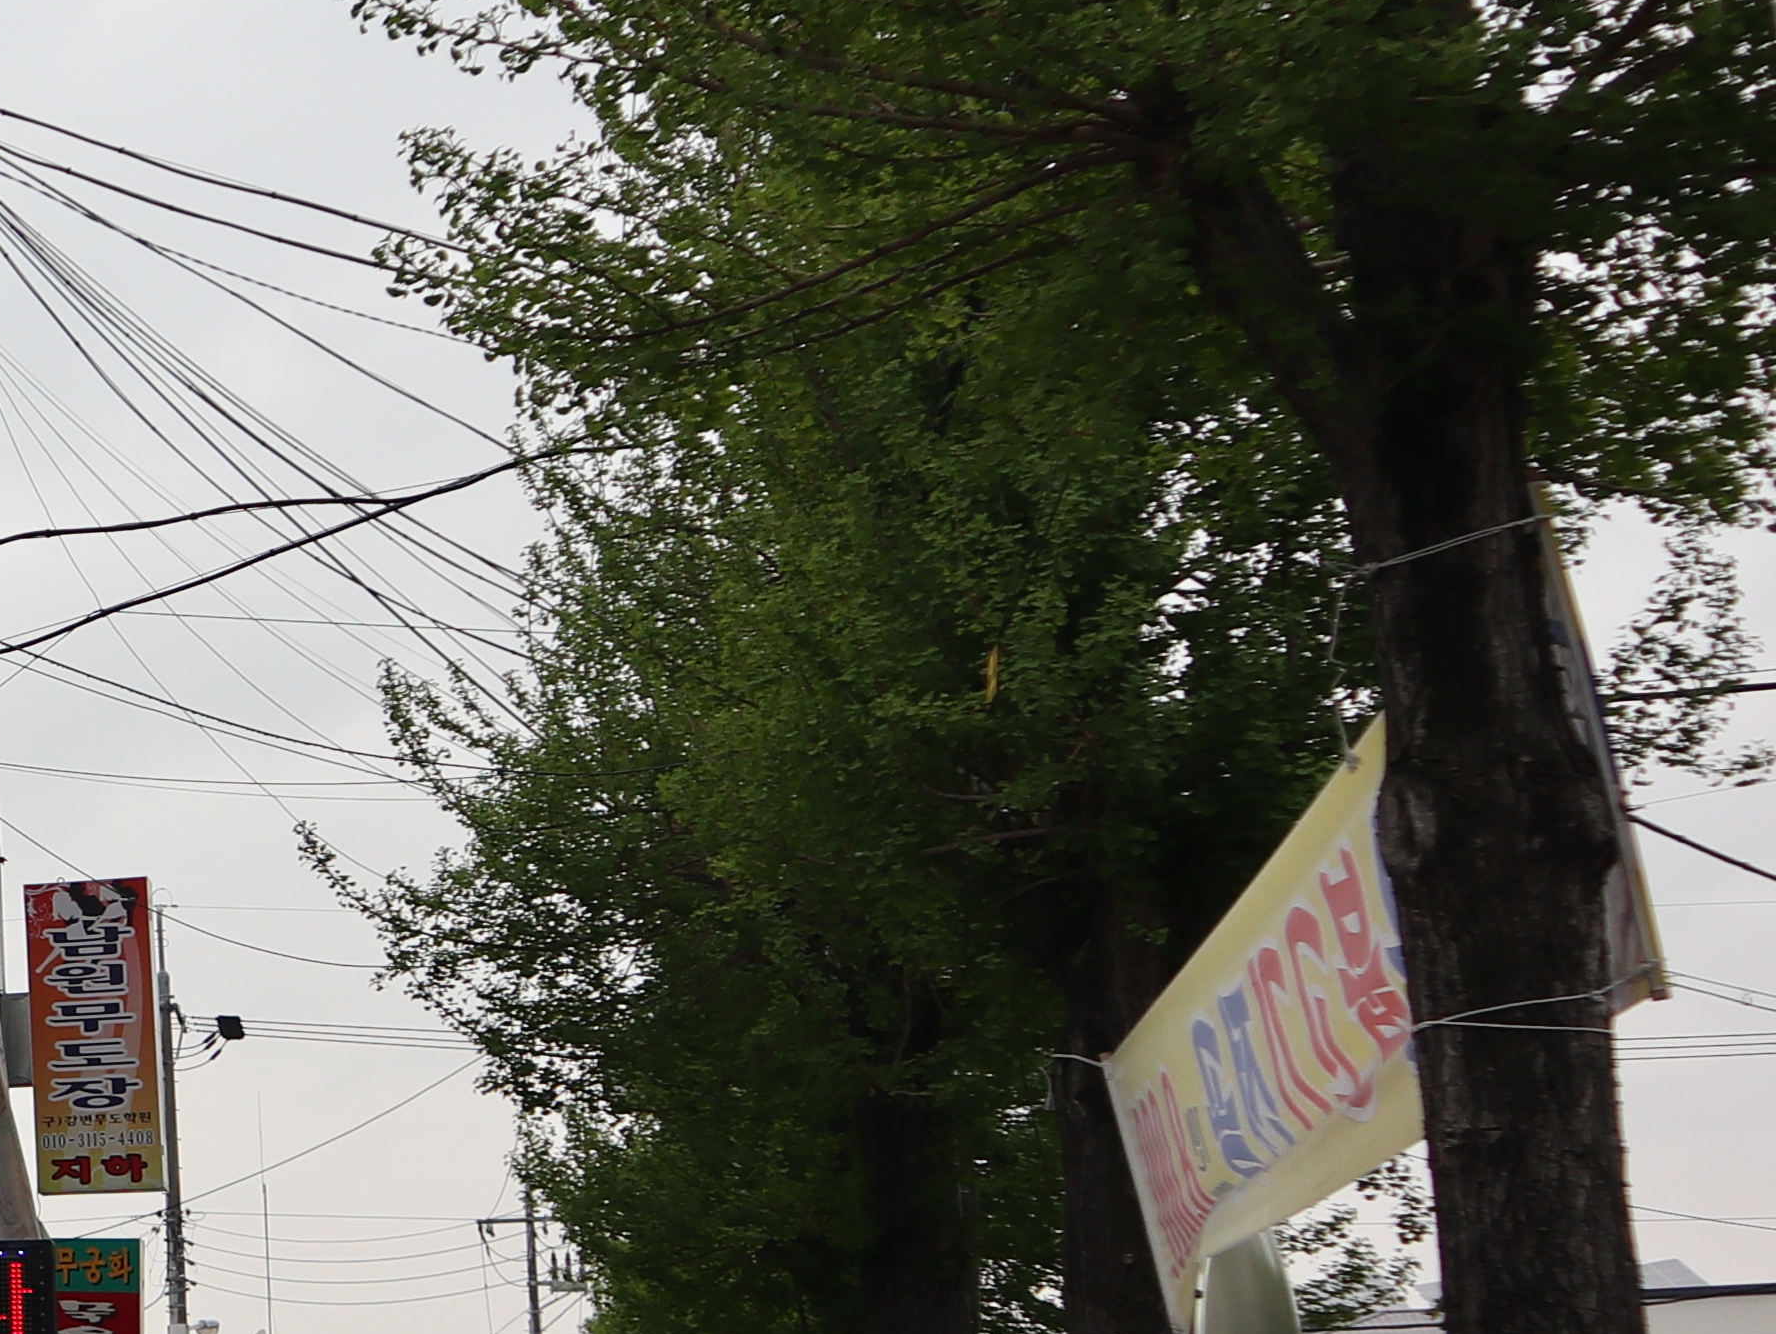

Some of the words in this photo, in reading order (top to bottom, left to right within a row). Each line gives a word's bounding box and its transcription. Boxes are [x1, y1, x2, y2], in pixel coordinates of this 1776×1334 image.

[45, 920, 142, 1110] 남원무도장
[42, 1130, 154, 1150] 010-3115-4408
[52, 1154, 148, 1185] 지하
[55, 1245, 133, 1284] 무궁화
